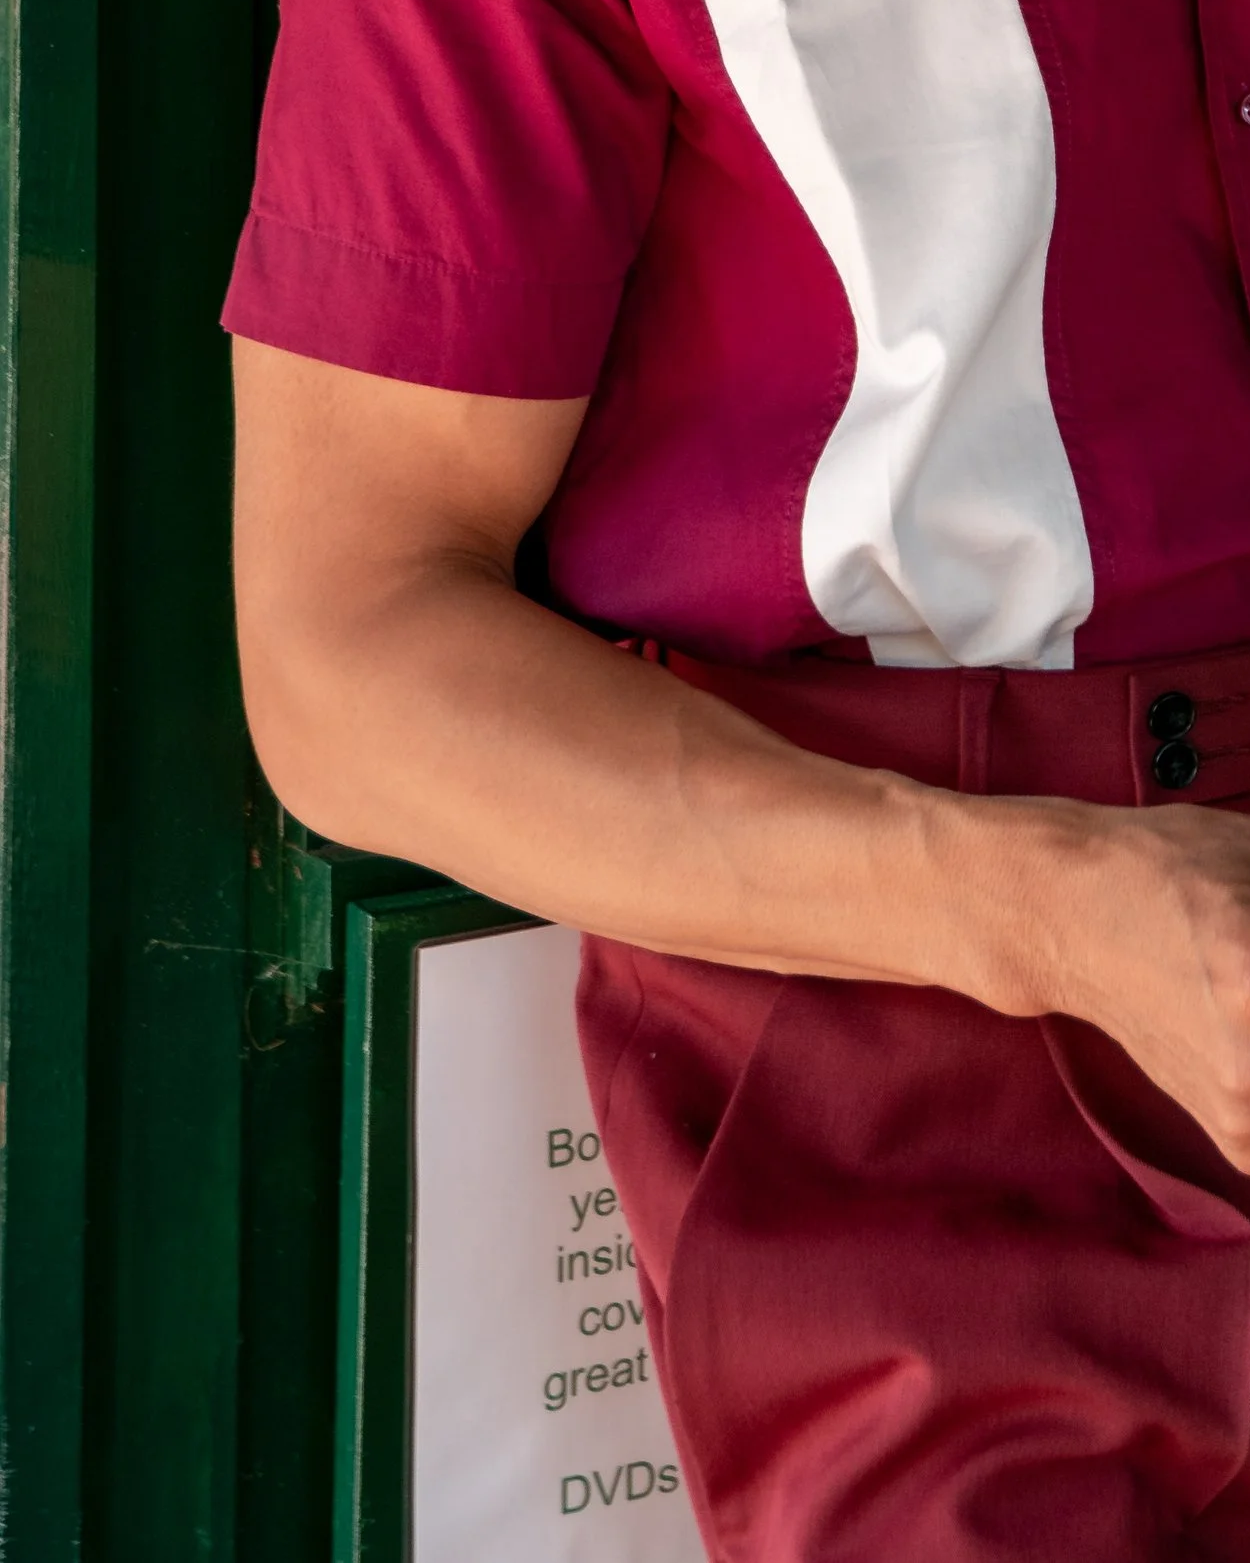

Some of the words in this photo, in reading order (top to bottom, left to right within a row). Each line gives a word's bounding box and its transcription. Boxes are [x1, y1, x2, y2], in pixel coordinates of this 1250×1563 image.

[571, 1187, 622, 1233] ye
[579, 1299, 644, 1337] cov
[543, 1347, 650, 1412] great
[560, 1460, 680, 1516] DVDs
